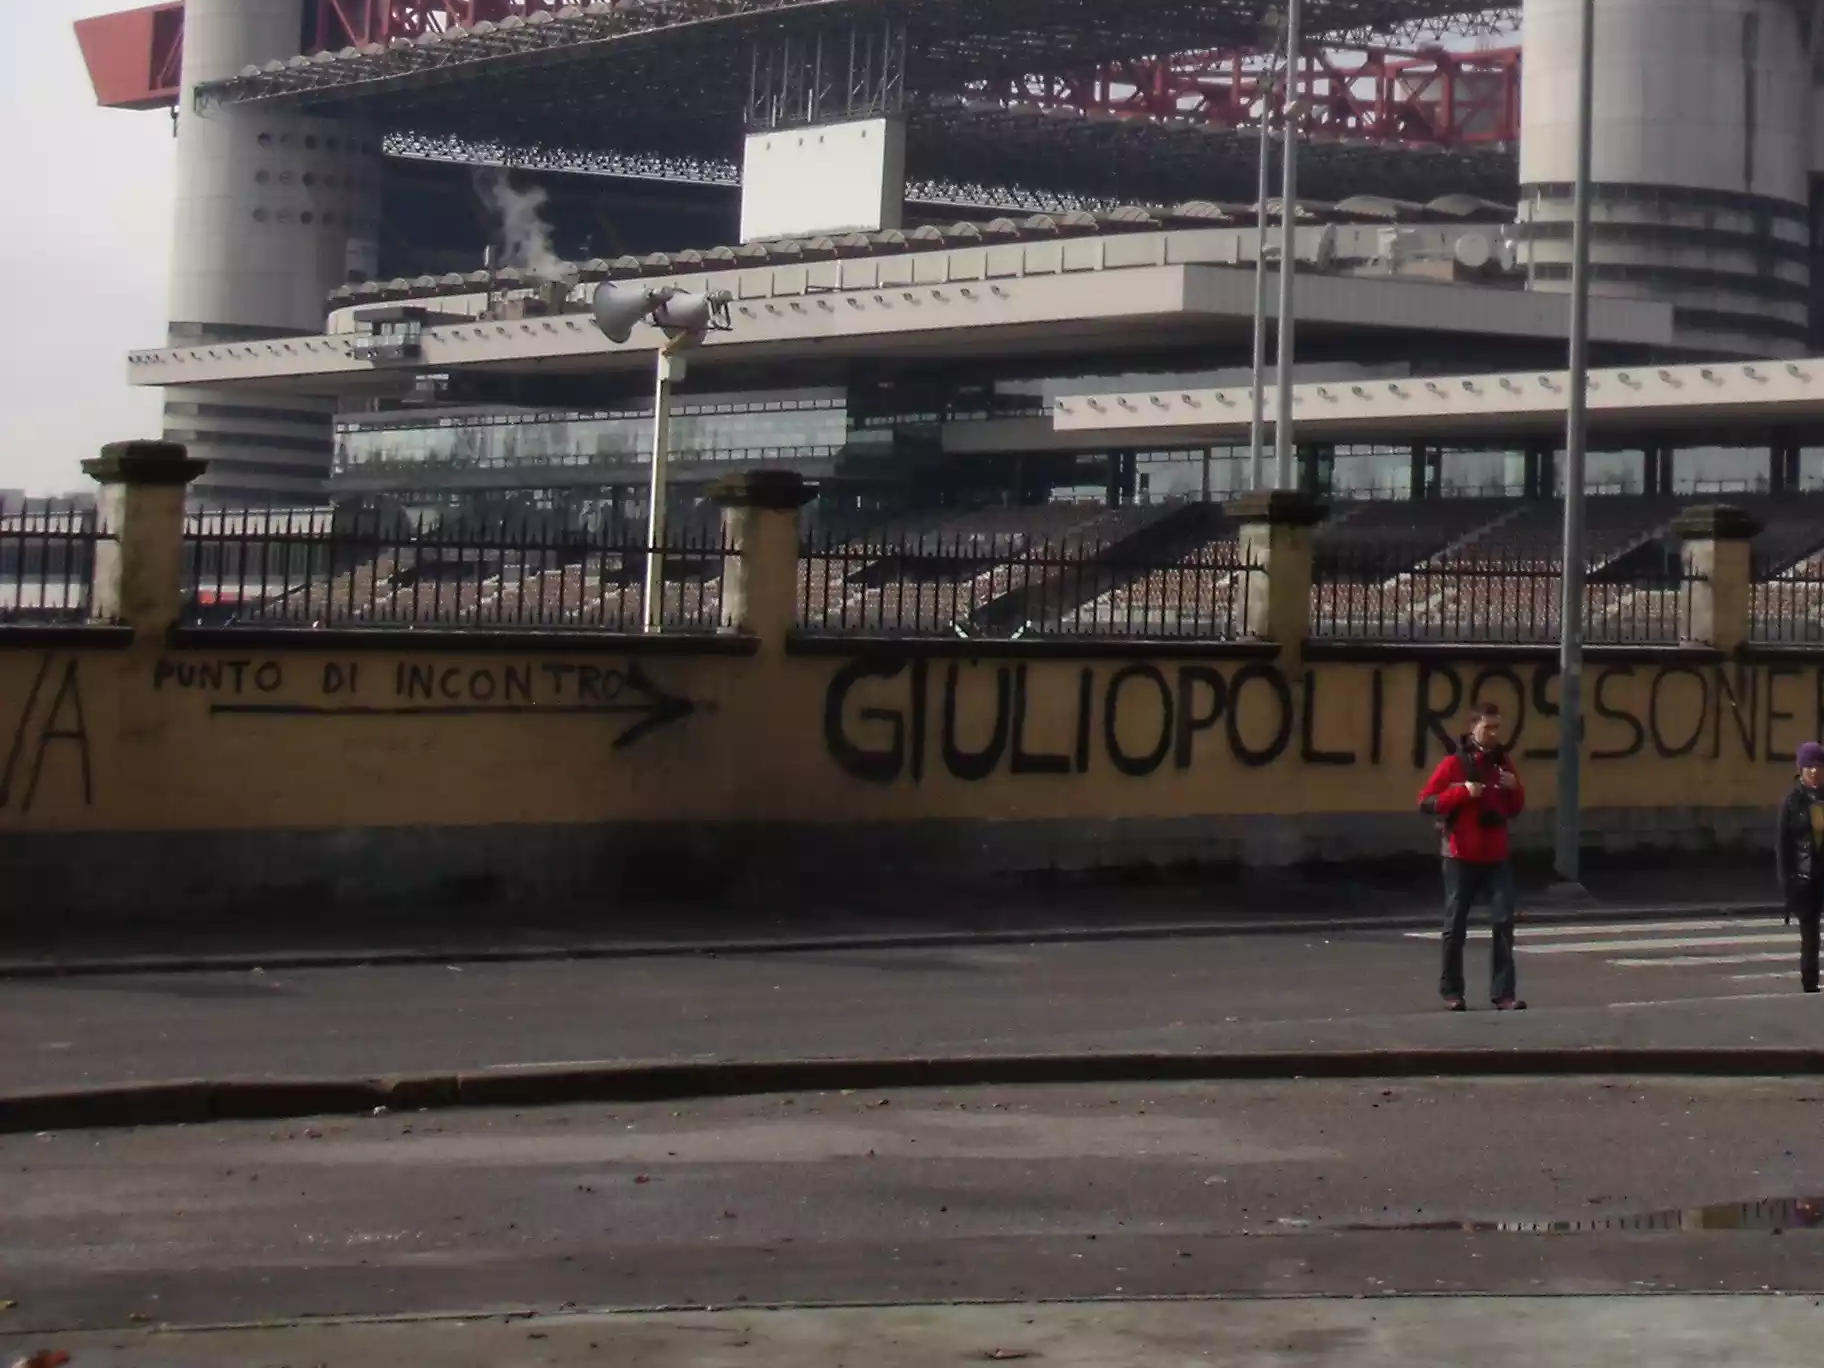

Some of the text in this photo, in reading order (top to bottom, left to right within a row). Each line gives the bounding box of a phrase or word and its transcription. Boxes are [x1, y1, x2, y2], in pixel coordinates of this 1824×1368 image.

[154, 659, 626, 702] PUNTO DI INCONTRO
